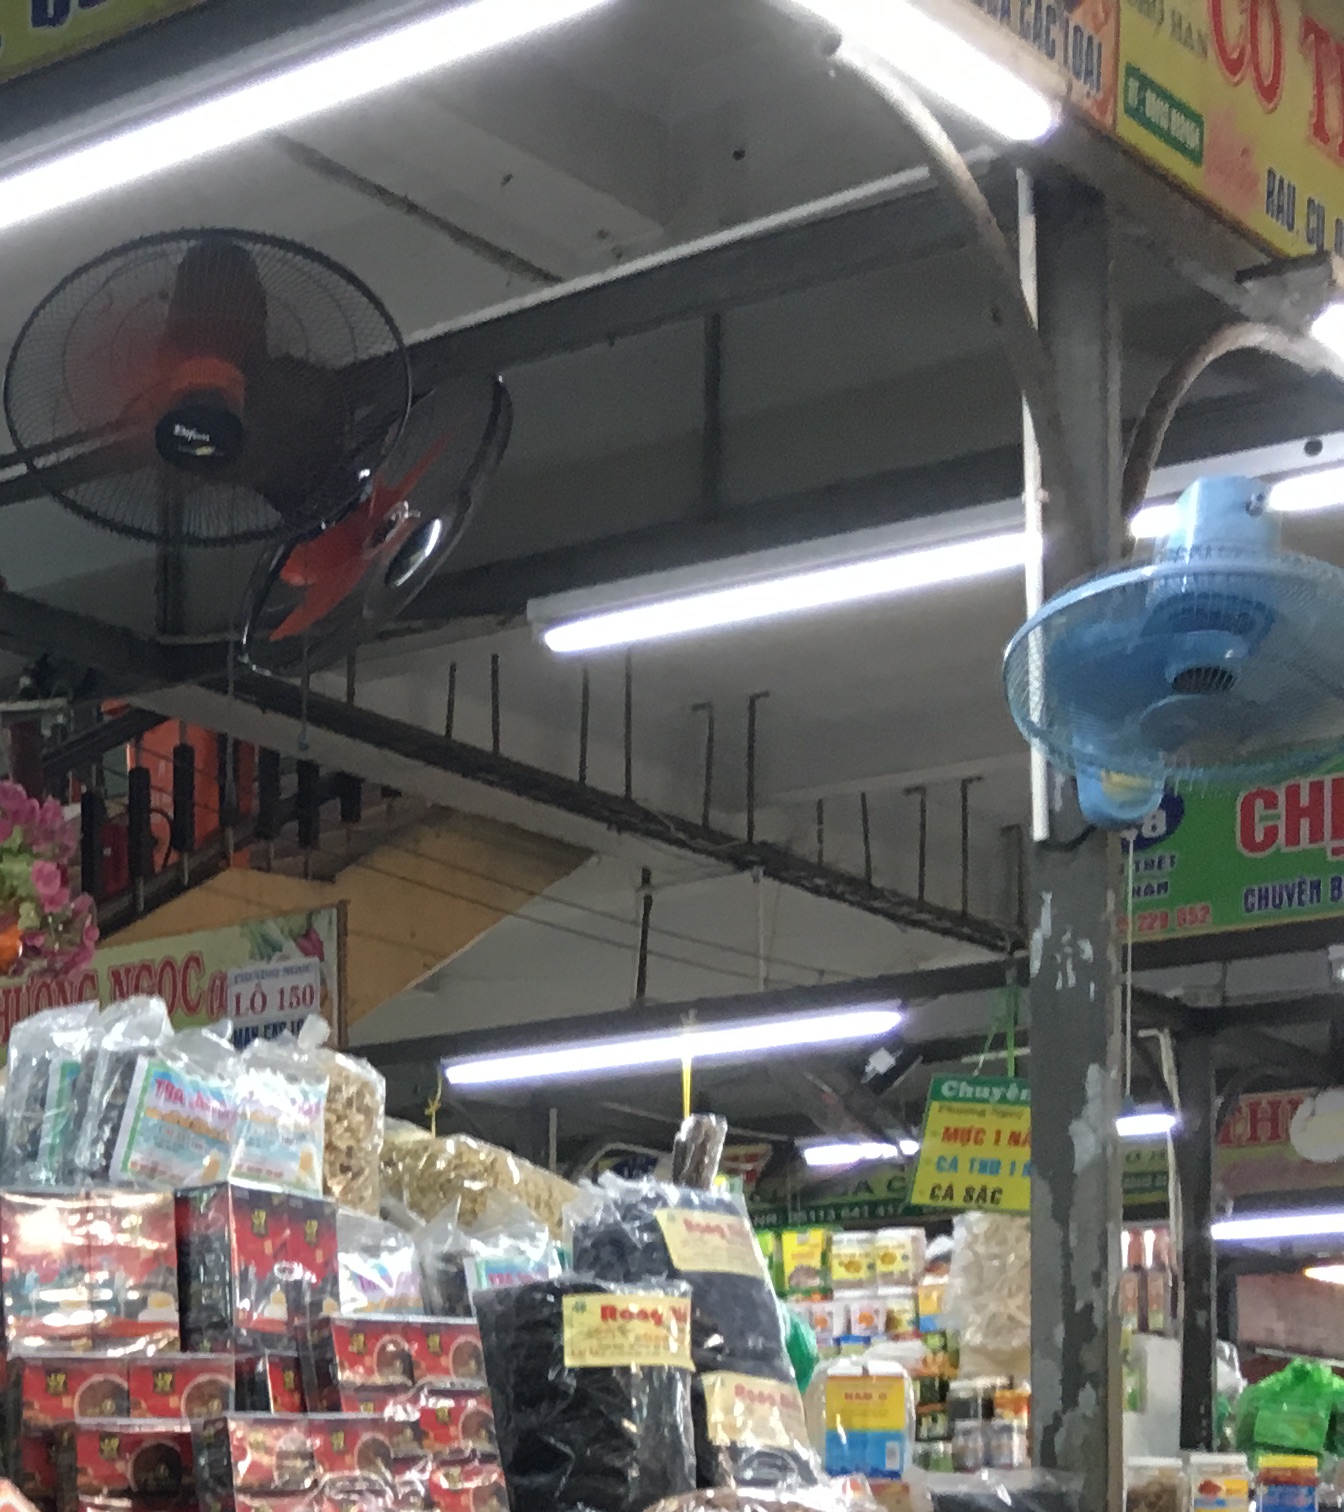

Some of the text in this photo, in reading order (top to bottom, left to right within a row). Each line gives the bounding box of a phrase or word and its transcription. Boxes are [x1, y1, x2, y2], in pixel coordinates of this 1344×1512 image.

[1242, 870, 1323, 914] CHUYÊN
[233, 982, 316, 1018] LÔ 150
